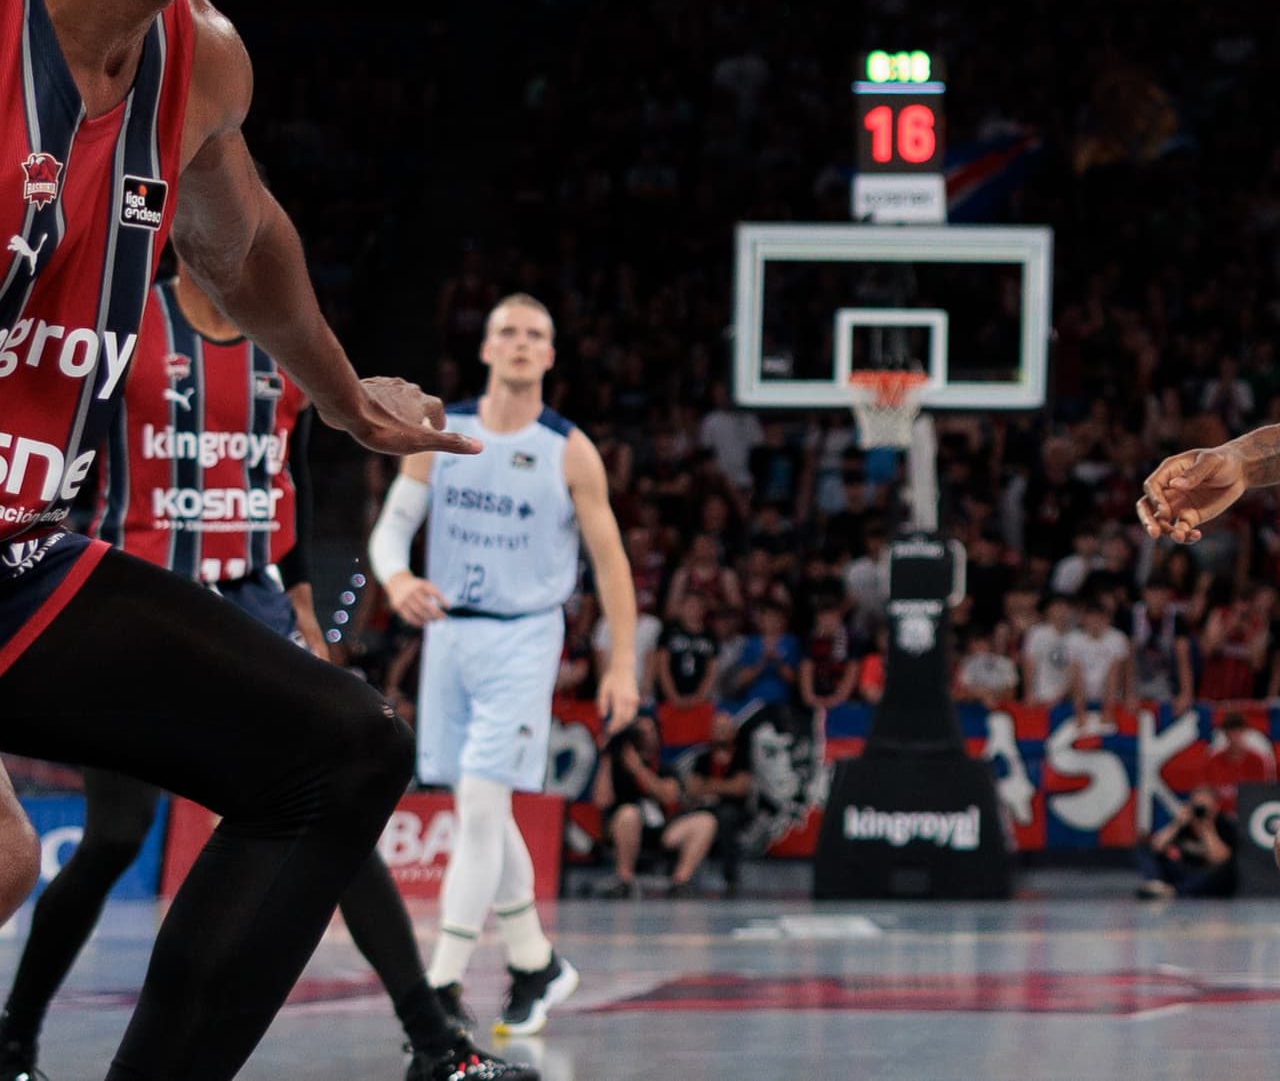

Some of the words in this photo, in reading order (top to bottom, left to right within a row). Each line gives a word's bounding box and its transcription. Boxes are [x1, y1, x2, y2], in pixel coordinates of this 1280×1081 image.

[864, 104, 936, 164] 16
[124, 206, 162, 224] endesa
[125, 190, 147, 208] liga
[0, 317, 137, 400] groy
